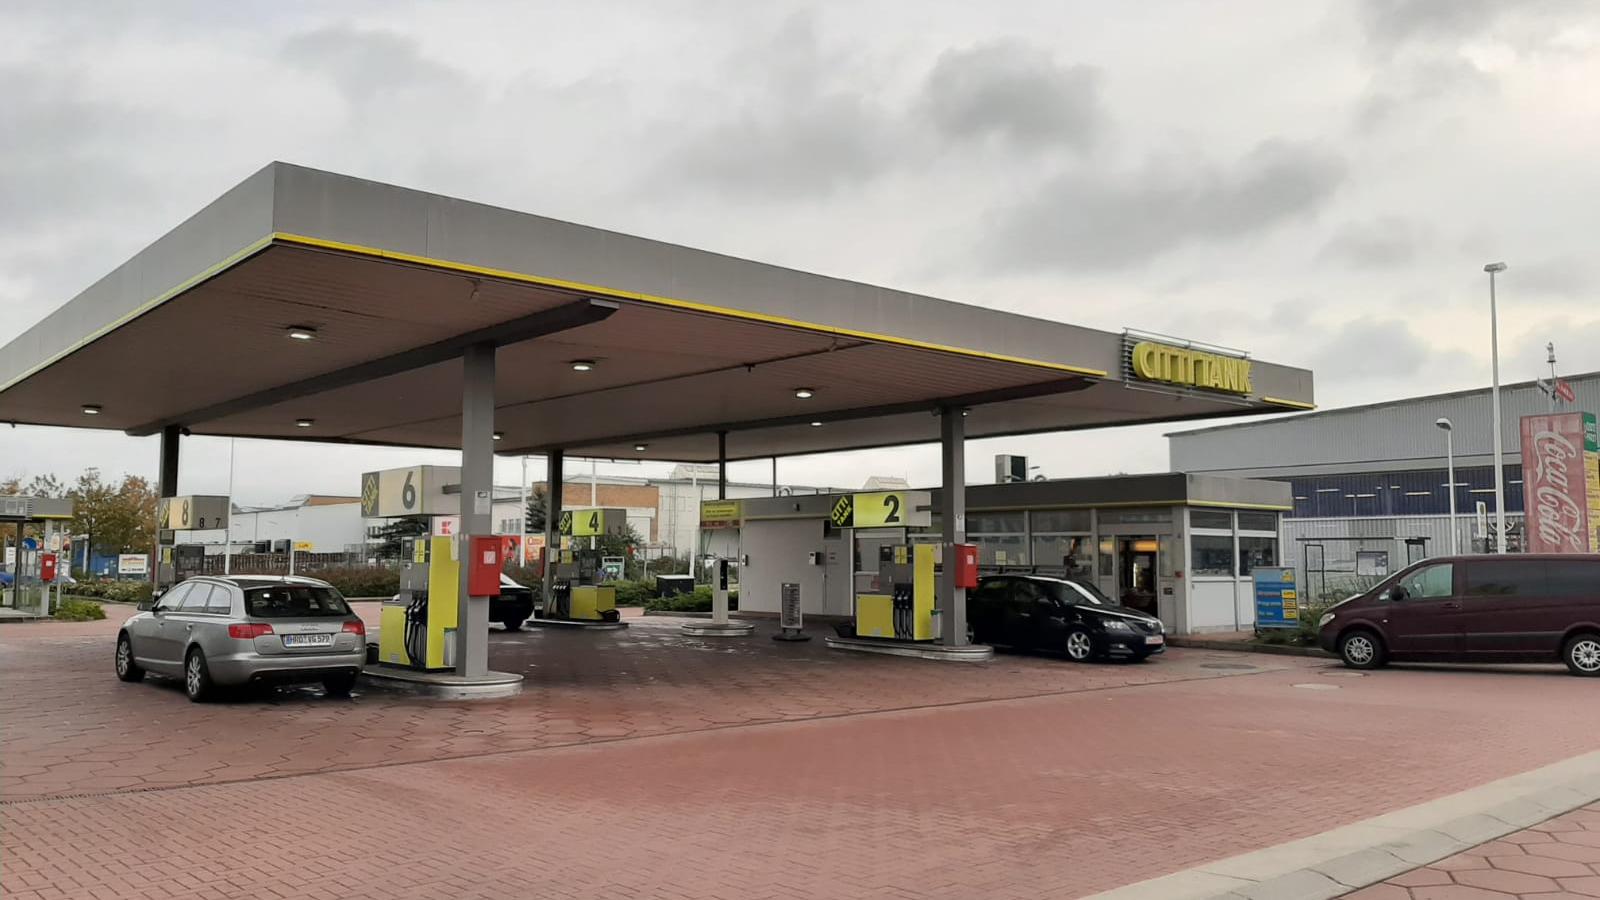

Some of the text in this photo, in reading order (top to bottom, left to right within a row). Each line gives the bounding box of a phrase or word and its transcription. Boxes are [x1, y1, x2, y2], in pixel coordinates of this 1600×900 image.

[1132, 341, 1252, 395] CITTI TANK
[402, 471, 416, 510] 6
[182, 499, 189, 526] 8
[589, 511, 599, 532] 4
[832, 496, 849, 521] CITTI
[883, 495, 900, 523] 2
[199, 517, 221, 528] 8 7
